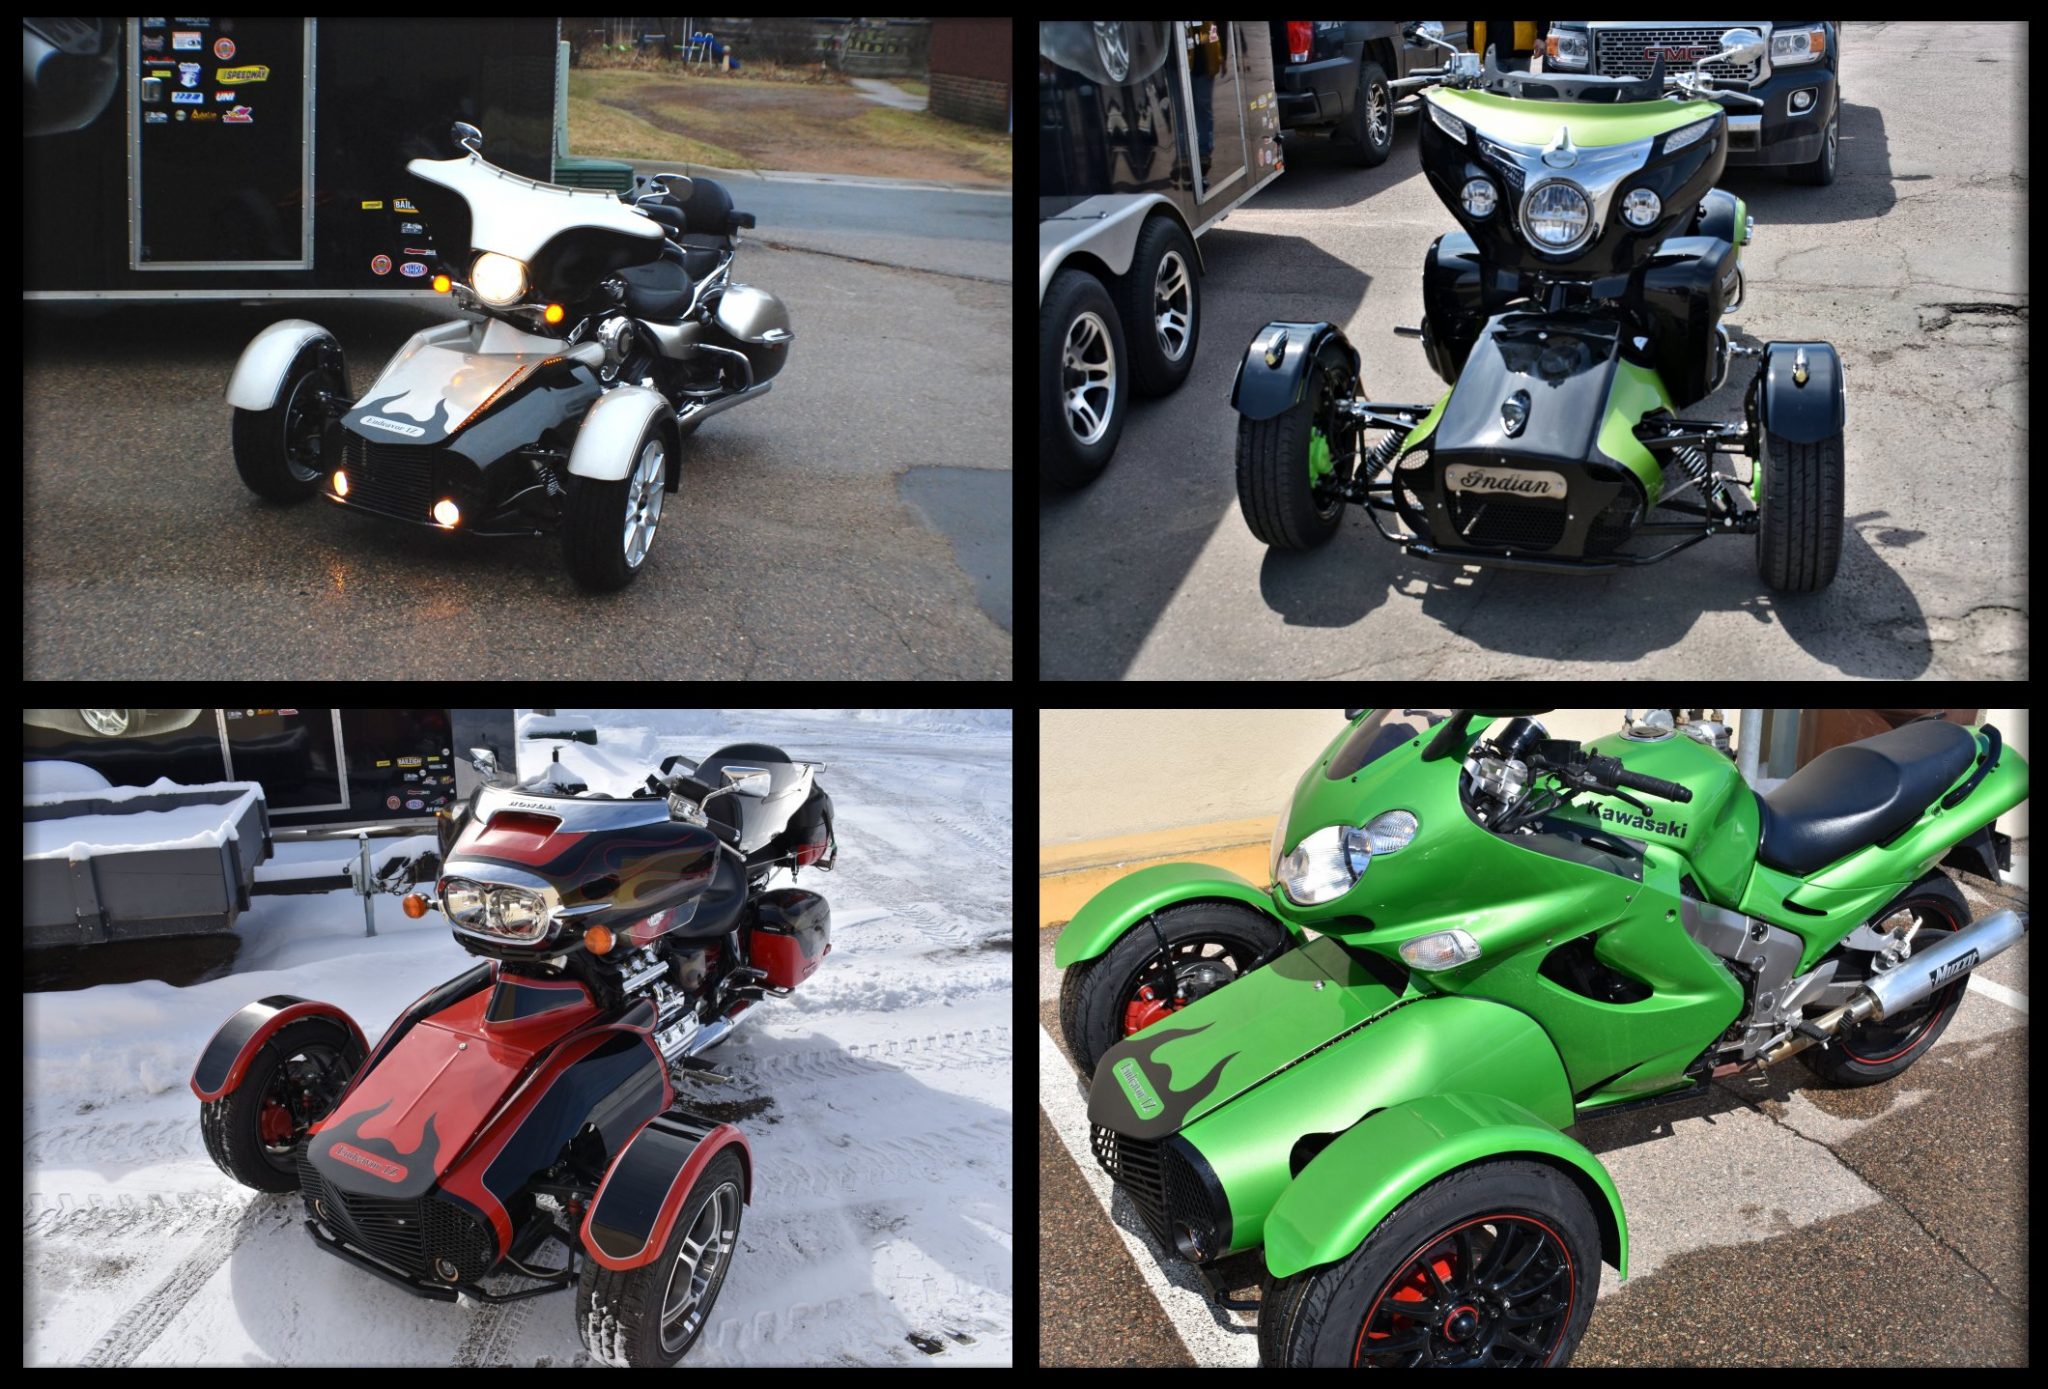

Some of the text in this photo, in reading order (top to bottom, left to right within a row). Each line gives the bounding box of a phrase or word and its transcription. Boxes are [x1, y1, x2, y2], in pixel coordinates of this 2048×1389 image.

[1644, 46, 1707, 61] GMC
[1460, 469, 1551, 493] Indian
[1587, 800, 1688, 838] Kawasaki
